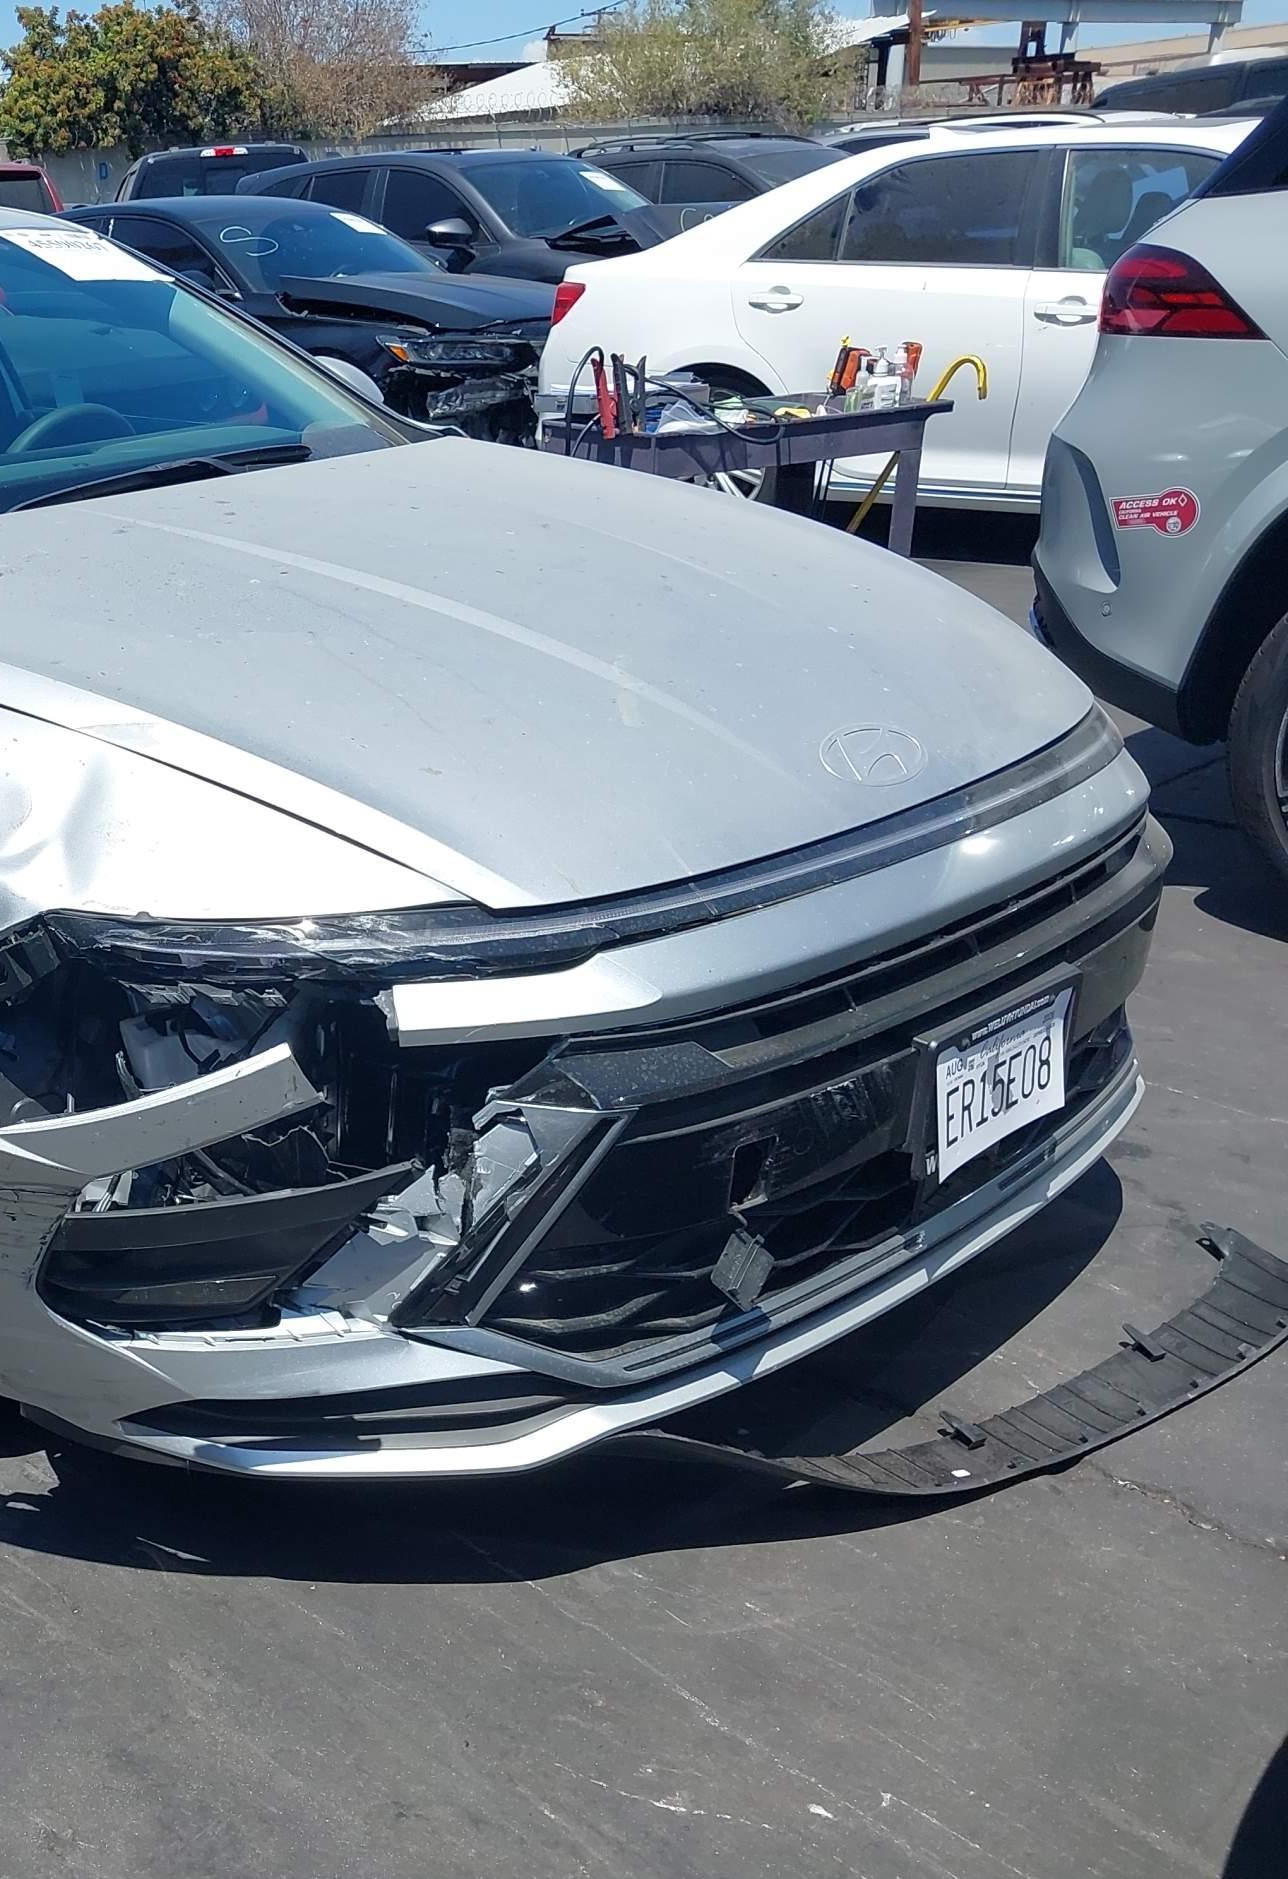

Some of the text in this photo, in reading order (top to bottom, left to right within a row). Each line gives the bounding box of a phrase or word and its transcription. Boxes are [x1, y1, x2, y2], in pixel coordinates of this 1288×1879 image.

[1119, 497, 1178, 510] ACCESS OK
[946, 1035, 1051, 1149] ER15E08
